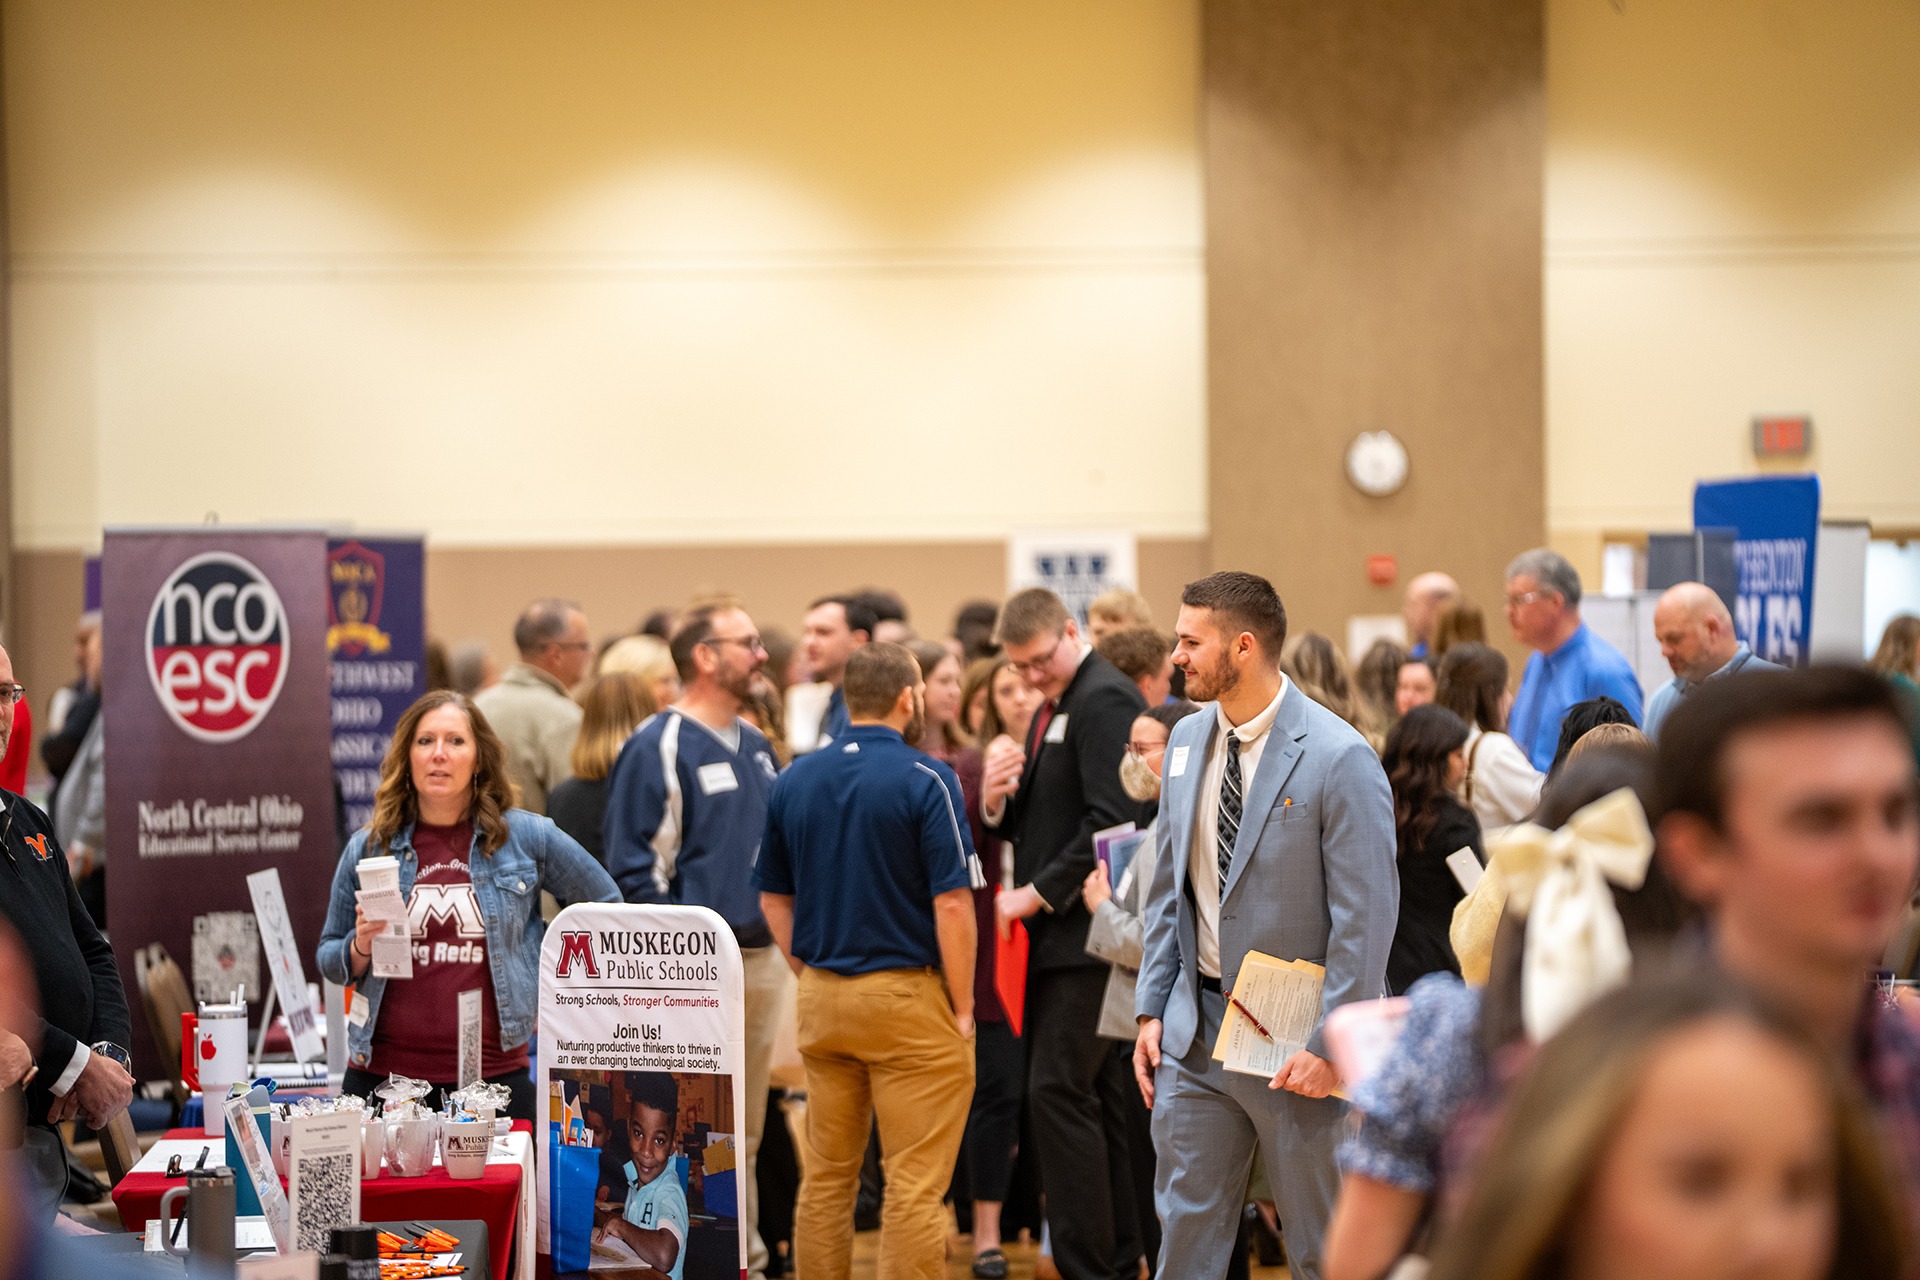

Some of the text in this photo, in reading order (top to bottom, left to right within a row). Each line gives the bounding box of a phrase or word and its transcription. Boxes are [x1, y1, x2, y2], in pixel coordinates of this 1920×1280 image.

[160, 581, 278, 645] nco
[161, 650, 271, 715] esc
[138, 794, 303, 833] North Central Ohio
[138, 829, 214, 860] Educational
[215, 828, 258, 855] Service
[412, 941, 430, 966] ig
[434, 941, 484, 963] Reds
[556, 931, 716, 979] M MUSKEGON
[607, 959, 718, 981] Public Schools
[555, 993, 719, 1009] Strong Schools, Stronger Communities
[613, 1023, 661, 1040] Join Us!
[556, 1039, 721, 1056] Nurturing productive thinkers to thrive in
[557, 1054, 720, 1072] an ever changing technological society.
[640, 1202, 653, 1225] H
